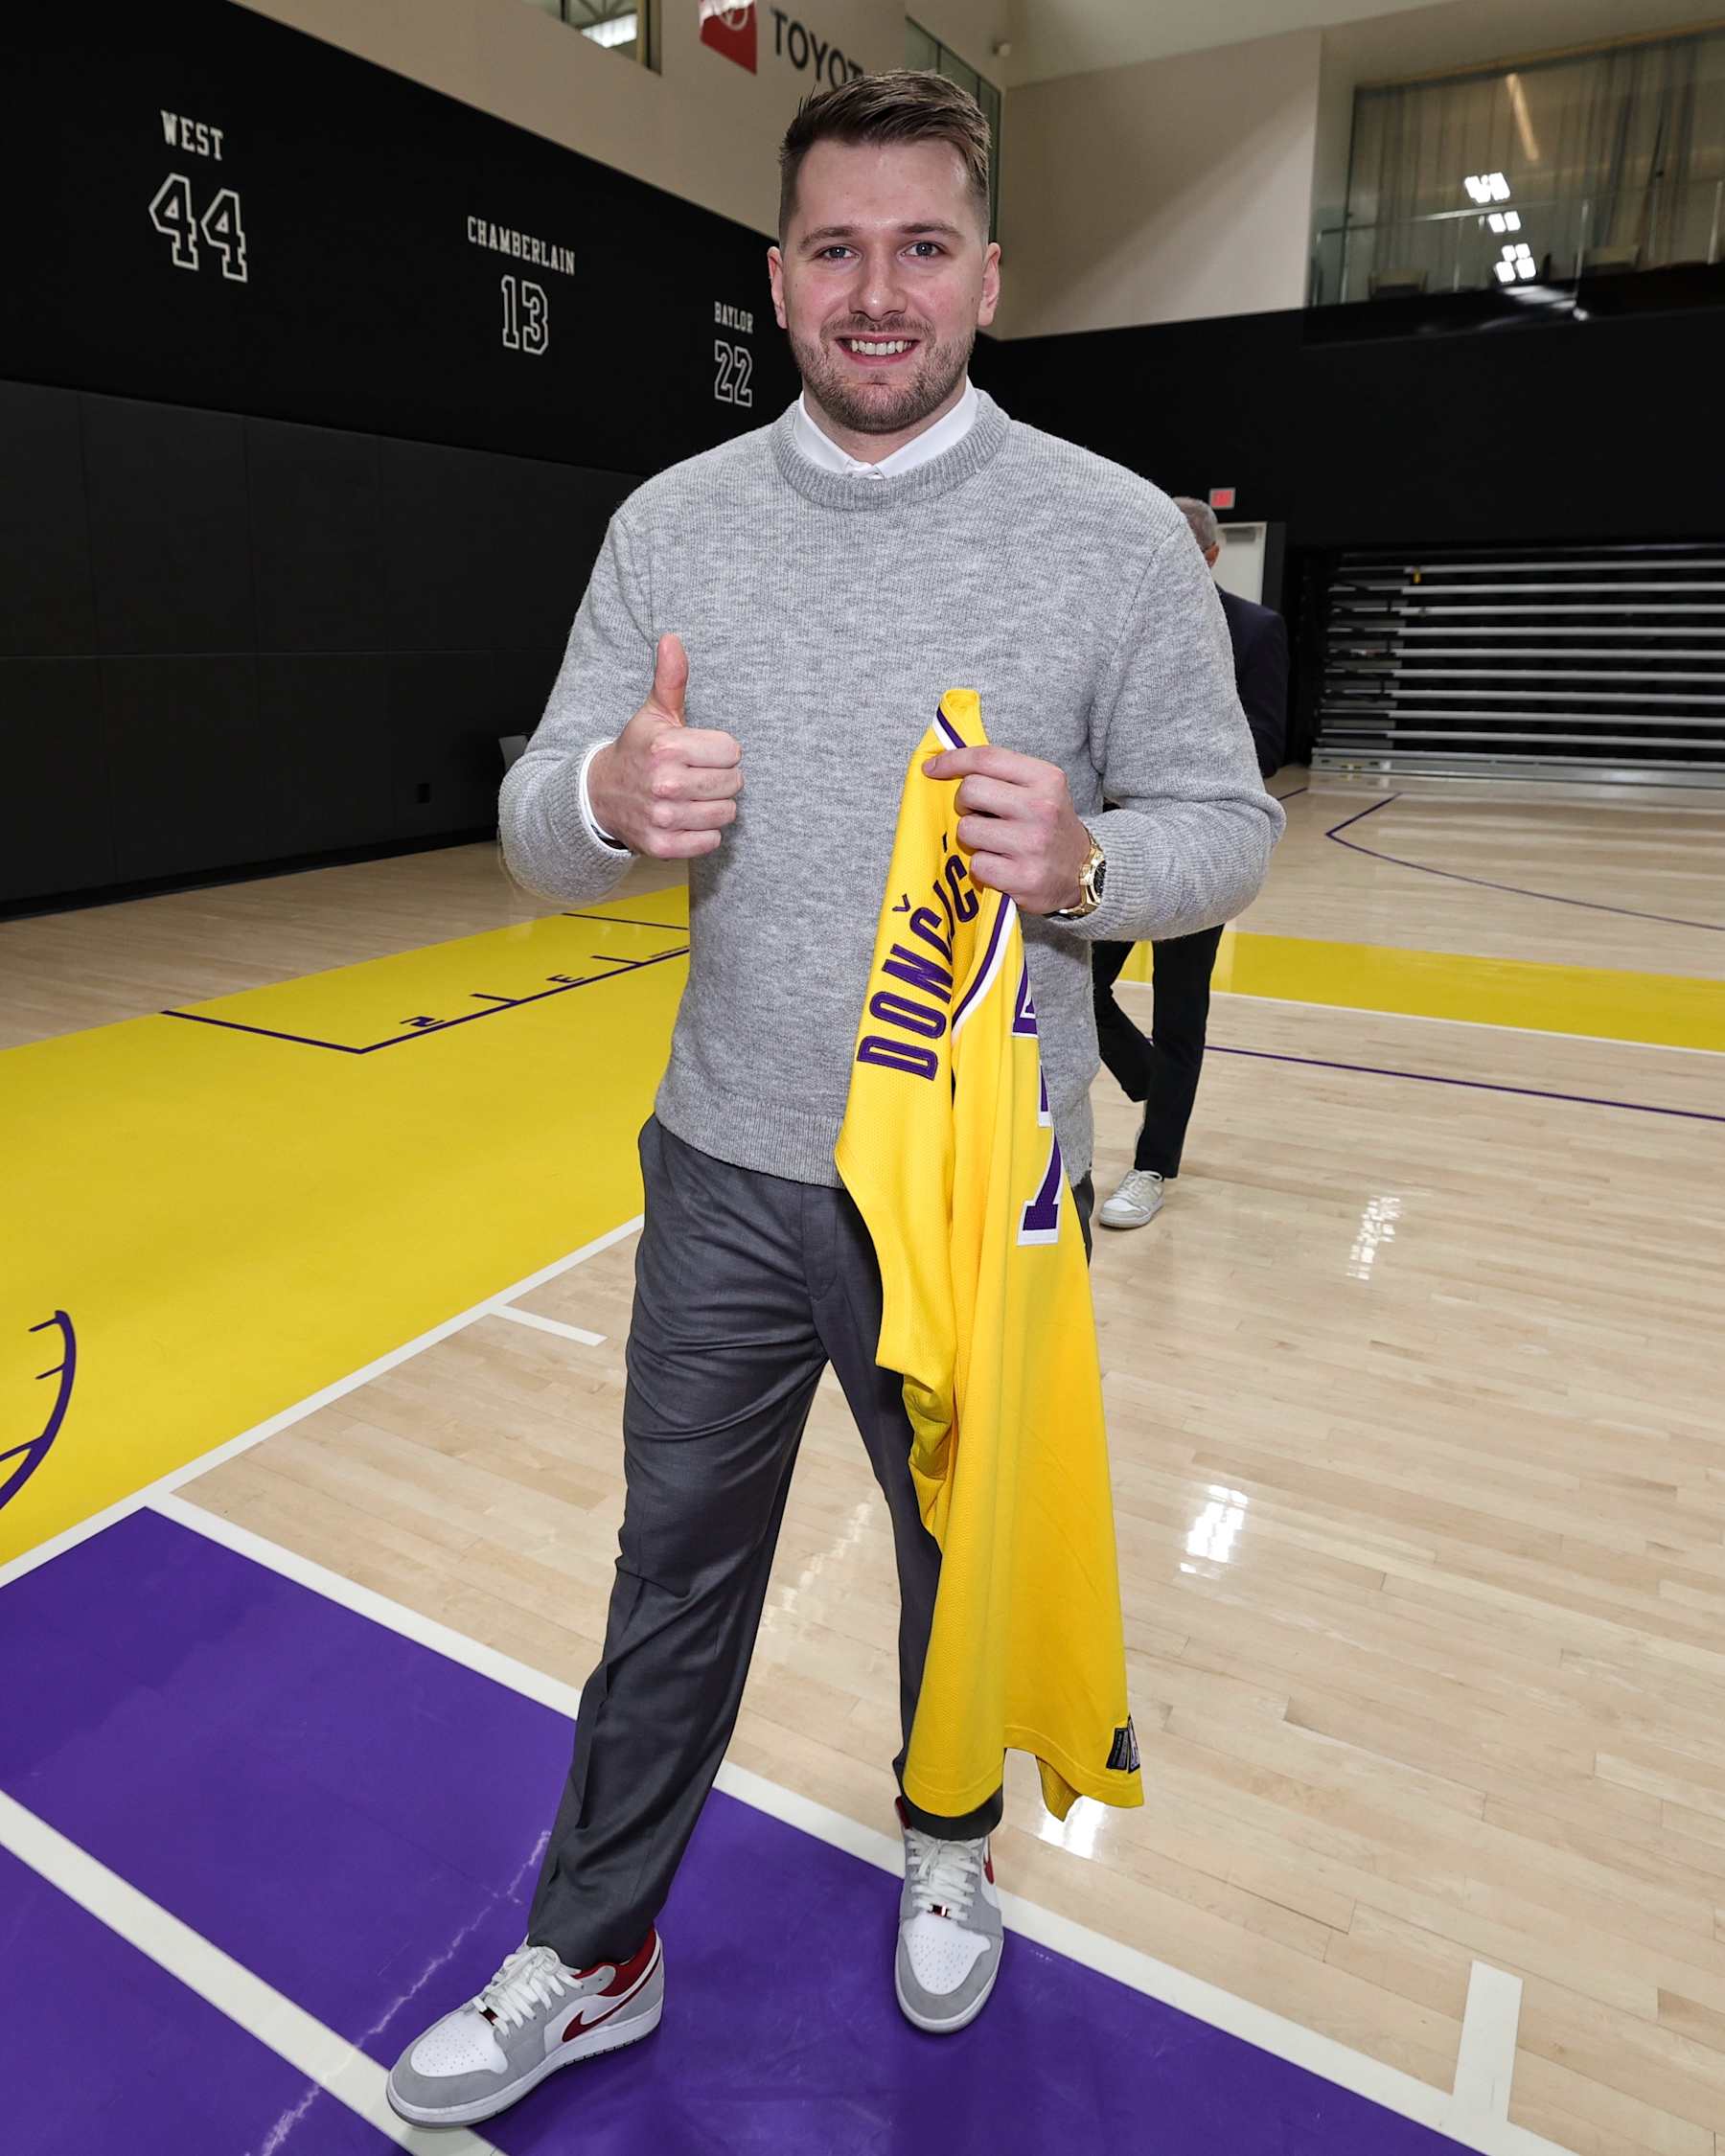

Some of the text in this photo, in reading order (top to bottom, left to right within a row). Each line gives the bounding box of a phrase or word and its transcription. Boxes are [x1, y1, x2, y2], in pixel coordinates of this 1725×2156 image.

[160, 109, 223, 161] WEST
[149, 172, 247, 283] 44
[467, 216, 575, 276] CHAMBERLAIN
[501, 274, 548, 356] 13
[714, 301, 753, 334] BAYLOR
[714, 339, 753, 407] 22
